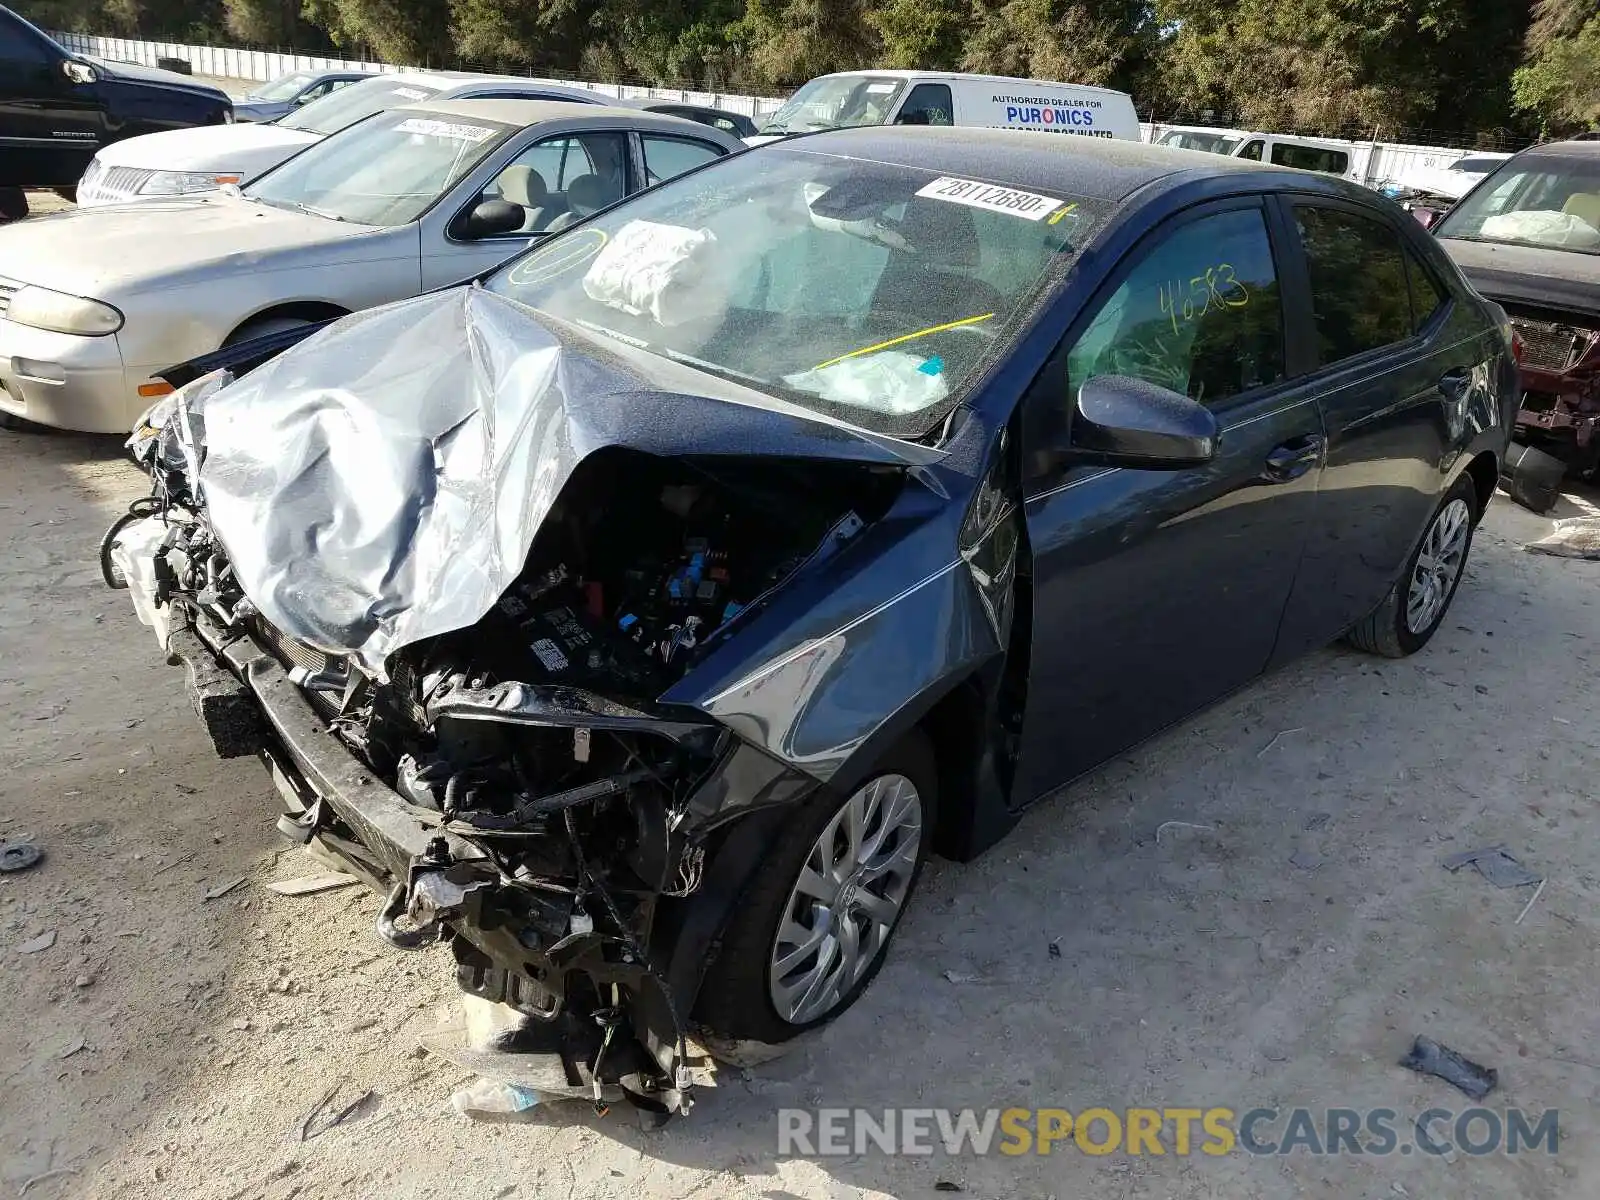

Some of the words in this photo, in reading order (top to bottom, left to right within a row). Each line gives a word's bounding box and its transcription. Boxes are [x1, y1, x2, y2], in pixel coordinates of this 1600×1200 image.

[992, 95, 1050, 106] AUTHORIZED
[1052, 98, 1084, 108] DEALER
[1086, 100, 1103, 109] FOR
[1007, 106, 1093, 126] PURONICS
